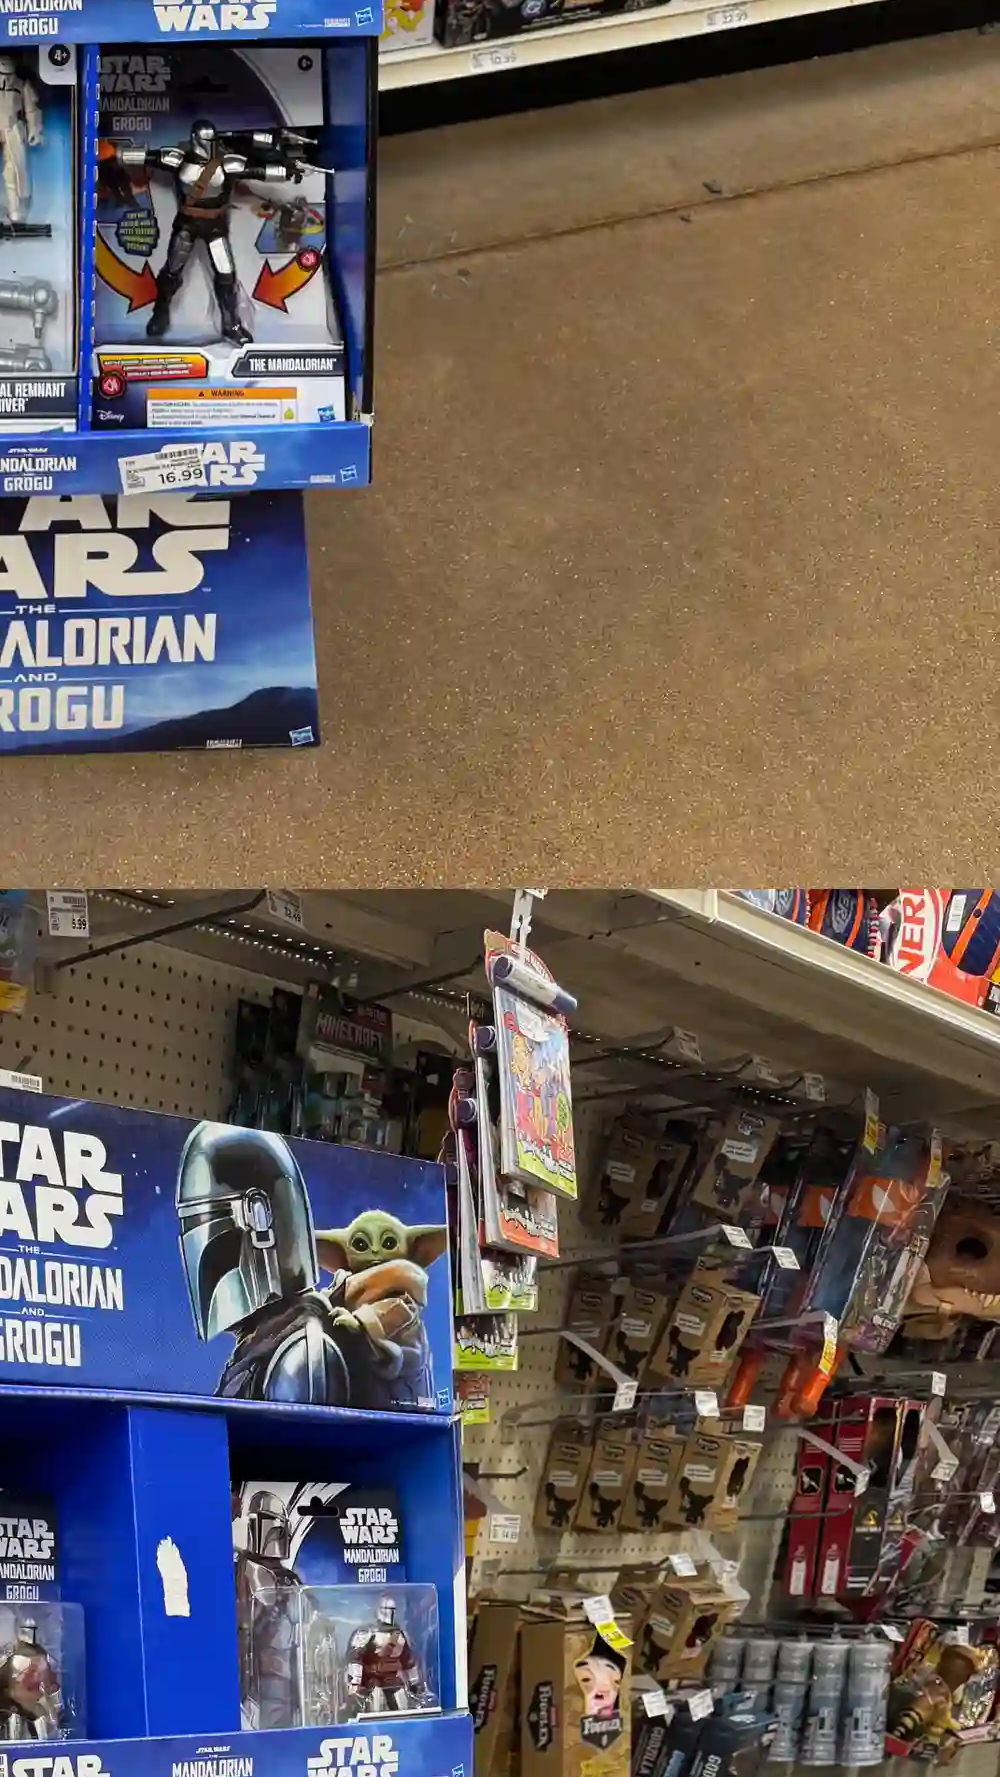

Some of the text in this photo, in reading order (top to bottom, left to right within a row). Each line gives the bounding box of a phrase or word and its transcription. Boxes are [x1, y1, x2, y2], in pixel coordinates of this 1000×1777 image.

[7, 17, 59, 36] GROGU
[153, 4, 278, 33] WARS
[249, 357, 335, 372] THE MANDALORIAN
[16, 380, 66, 398] REMNANT
[3, 474, 53, 492] GROGU
[157, 468, 203, 485] 16.99
[15, 603, 57, 614] THE
[12, 671, 58, 682] AND
[339, 1506, 399, 1528] STAR
[339, 1523, 399, 1546] WARS
[342, 1546, 400, 1565] MANDALORIAN
[5, 1584, 40, 1601] GROGU
[307, 1733, 399, 1771] STAR
